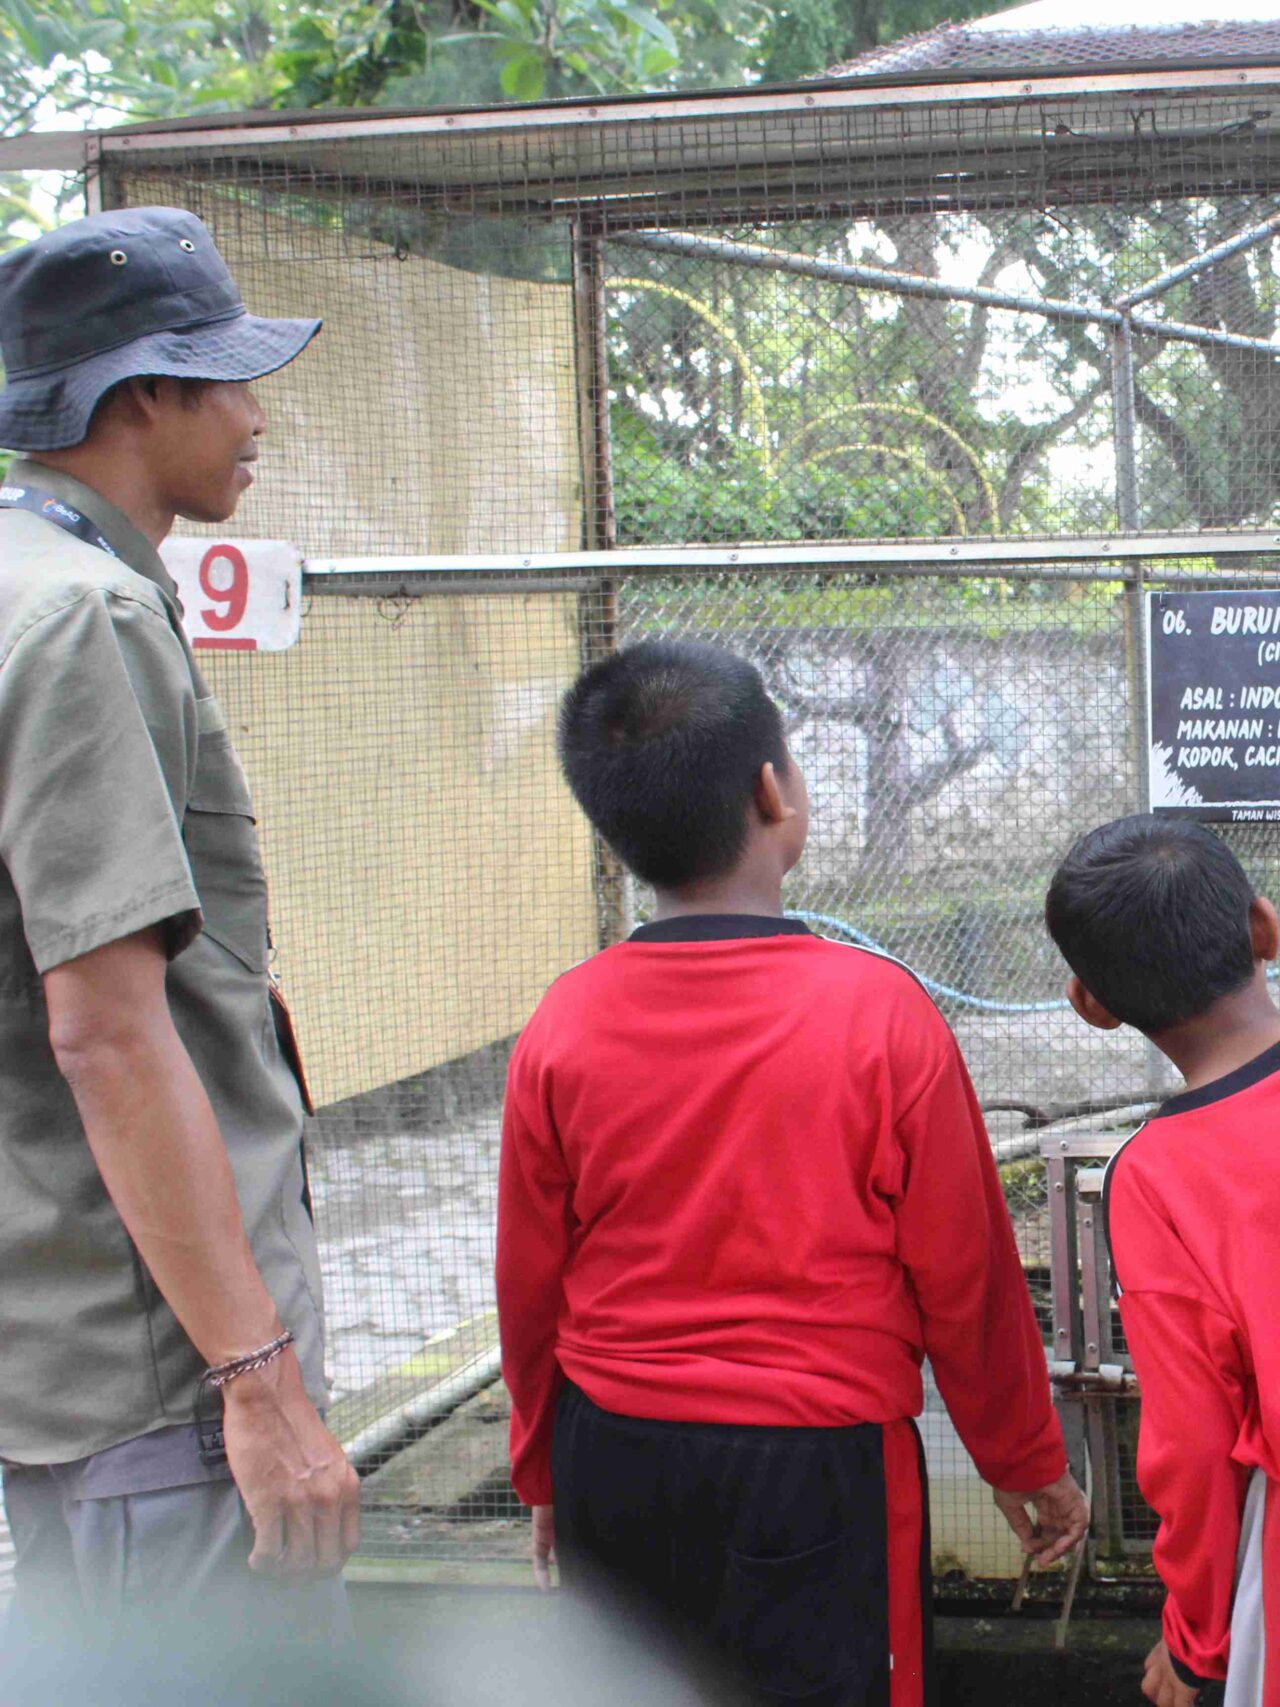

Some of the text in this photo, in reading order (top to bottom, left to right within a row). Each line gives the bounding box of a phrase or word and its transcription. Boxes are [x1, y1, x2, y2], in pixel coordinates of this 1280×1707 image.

[198, 543, 249, 632] 9
[1162, 609, 1192, 636] 06.
[1180, 686, 1223, 710] ASAL
[1176, 719, 1264, 741] MAKANAN
[1177, 746, 1239, 771] KODOK,
[1231, 809, 1264, 821] TAMAN
